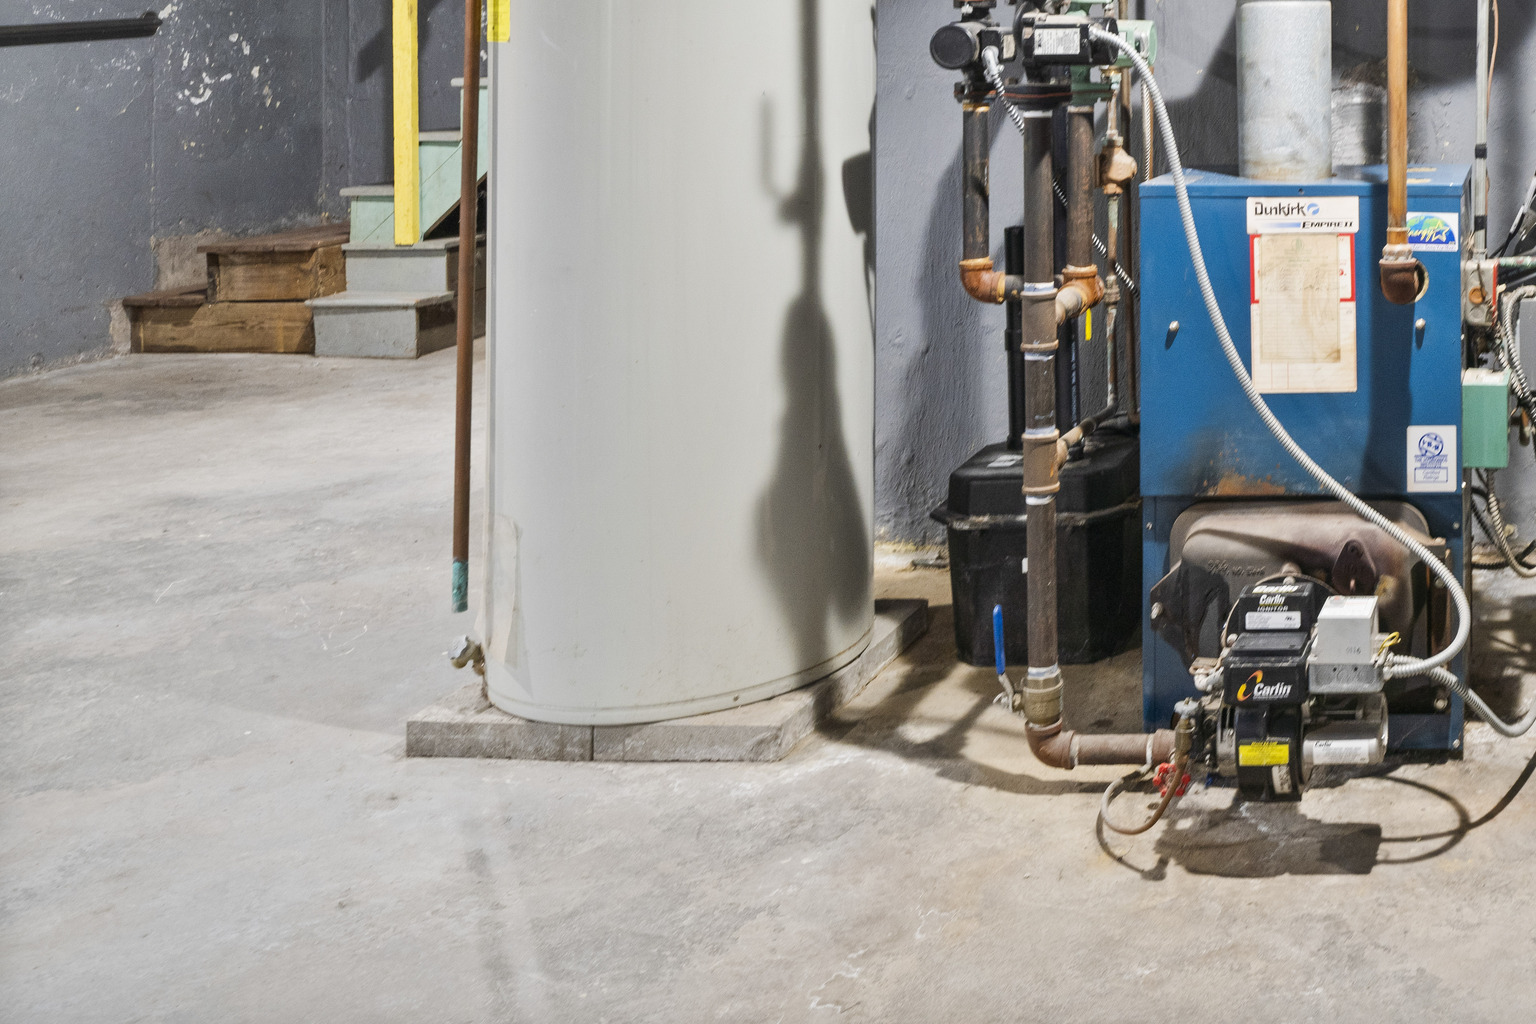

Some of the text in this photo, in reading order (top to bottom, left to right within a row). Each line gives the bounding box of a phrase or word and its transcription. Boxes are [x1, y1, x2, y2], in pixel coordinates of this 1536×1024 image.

[1254, 201, 1307, 217] Dunkirk
[1259, 594, 1286, 605] Carlin
[1253, 682, 1293, 697] Carlin
